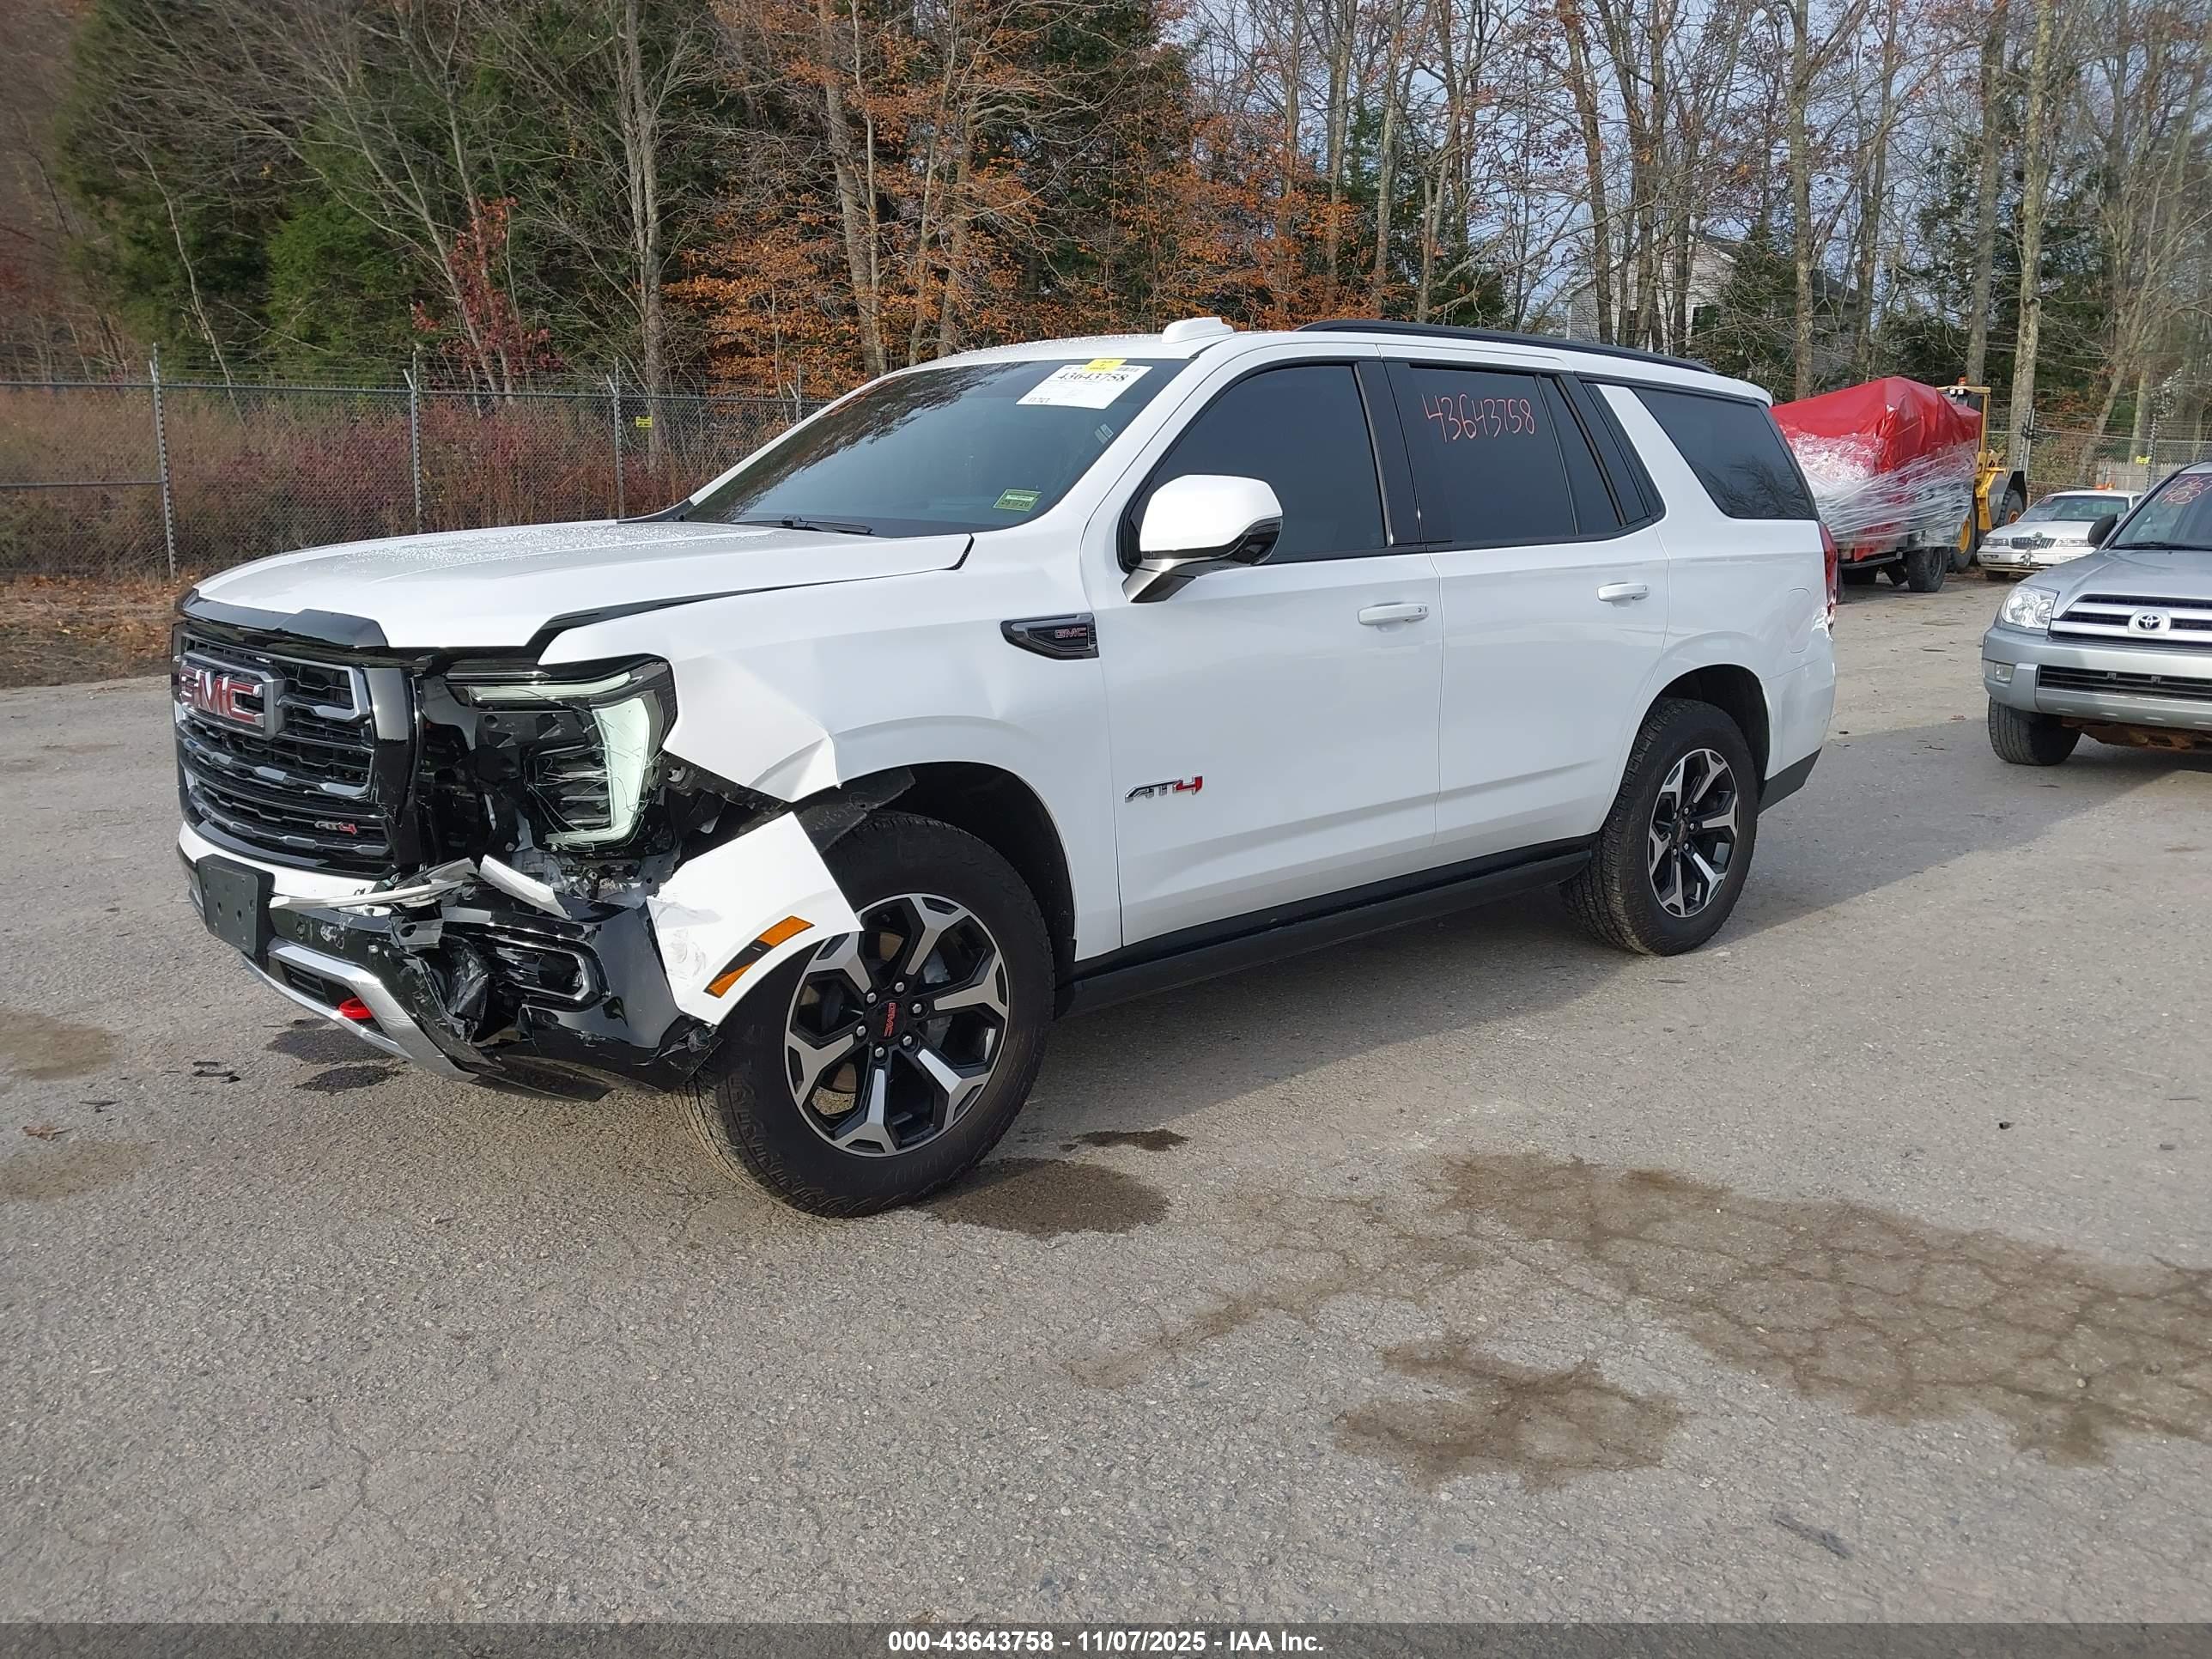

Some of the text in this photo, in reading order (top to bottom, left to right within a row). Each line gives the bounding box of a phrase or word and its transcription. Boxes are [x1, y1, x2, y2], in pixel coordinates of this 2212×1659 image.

[1057, 372, 1129, 383] 43643758
[1421, 393, 1535, 443] 43643758
[1054, 627, 1087, 639] GMC
[179, 665, 264, 728] GMC
[1125, 775, 1203, 803] AT4
[314, 821, 357, 835] AT4
[884, 1002, 896, 1037] GMC
